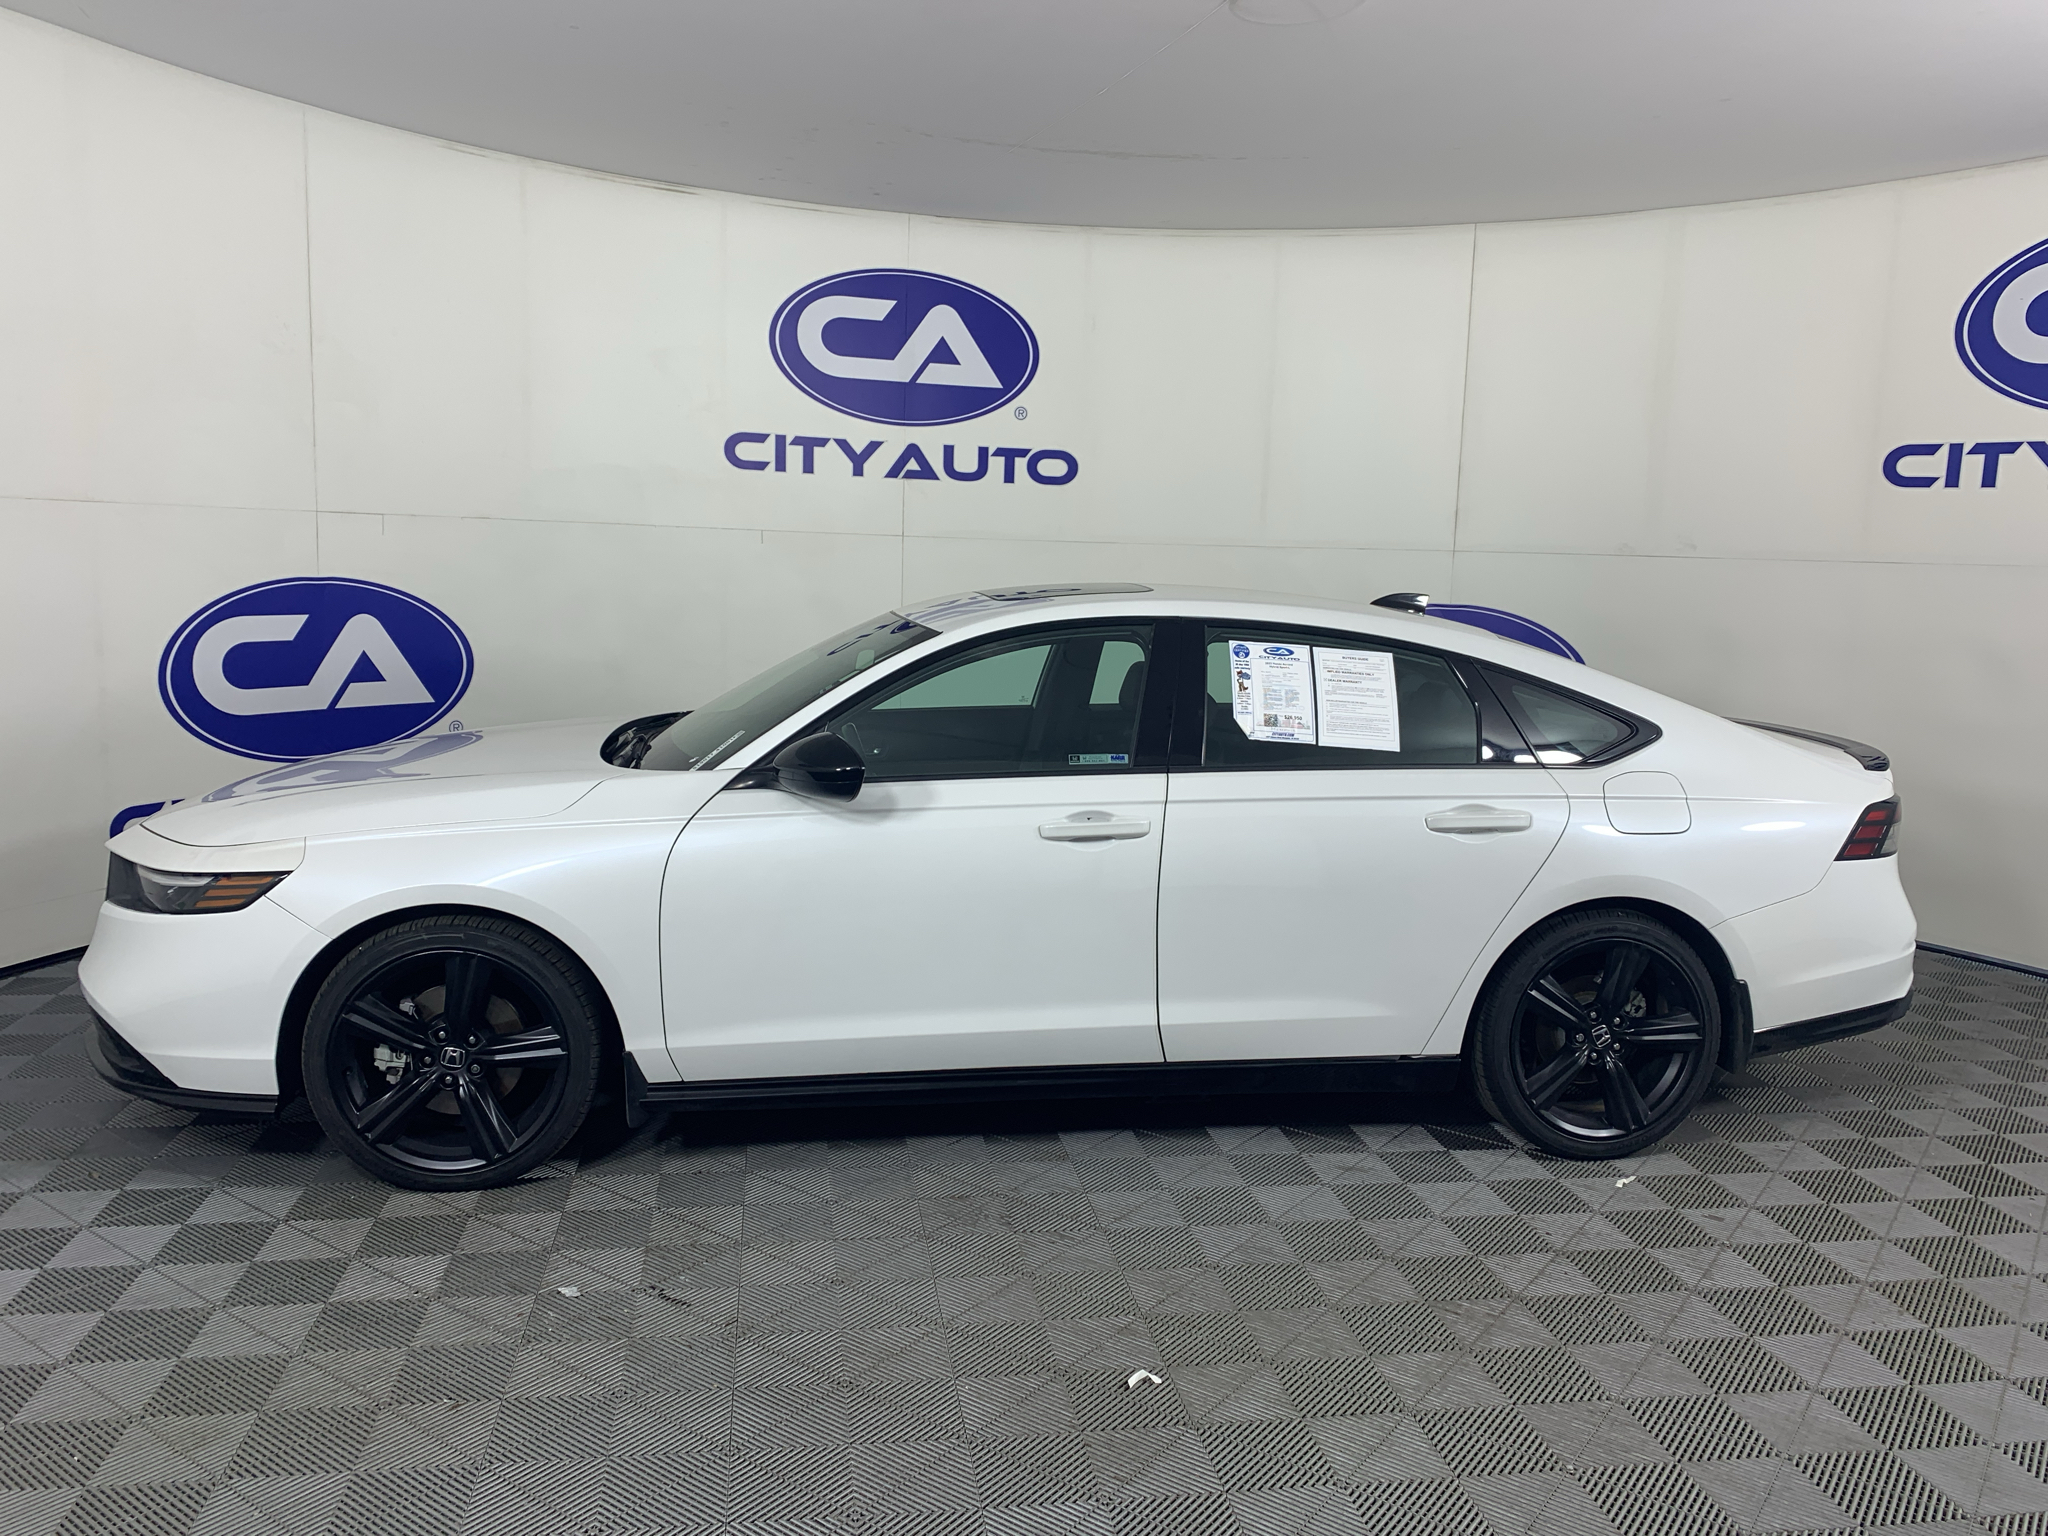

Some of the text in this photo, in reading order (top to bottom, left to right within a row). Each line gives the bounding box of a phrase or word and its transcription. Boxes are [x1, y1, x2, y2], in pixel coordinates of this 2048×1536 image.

[797, 295, 1003, 388] CA
[724, 432, 1079, 485] CITY AUTO
[192, 613, 435, 716] CA
